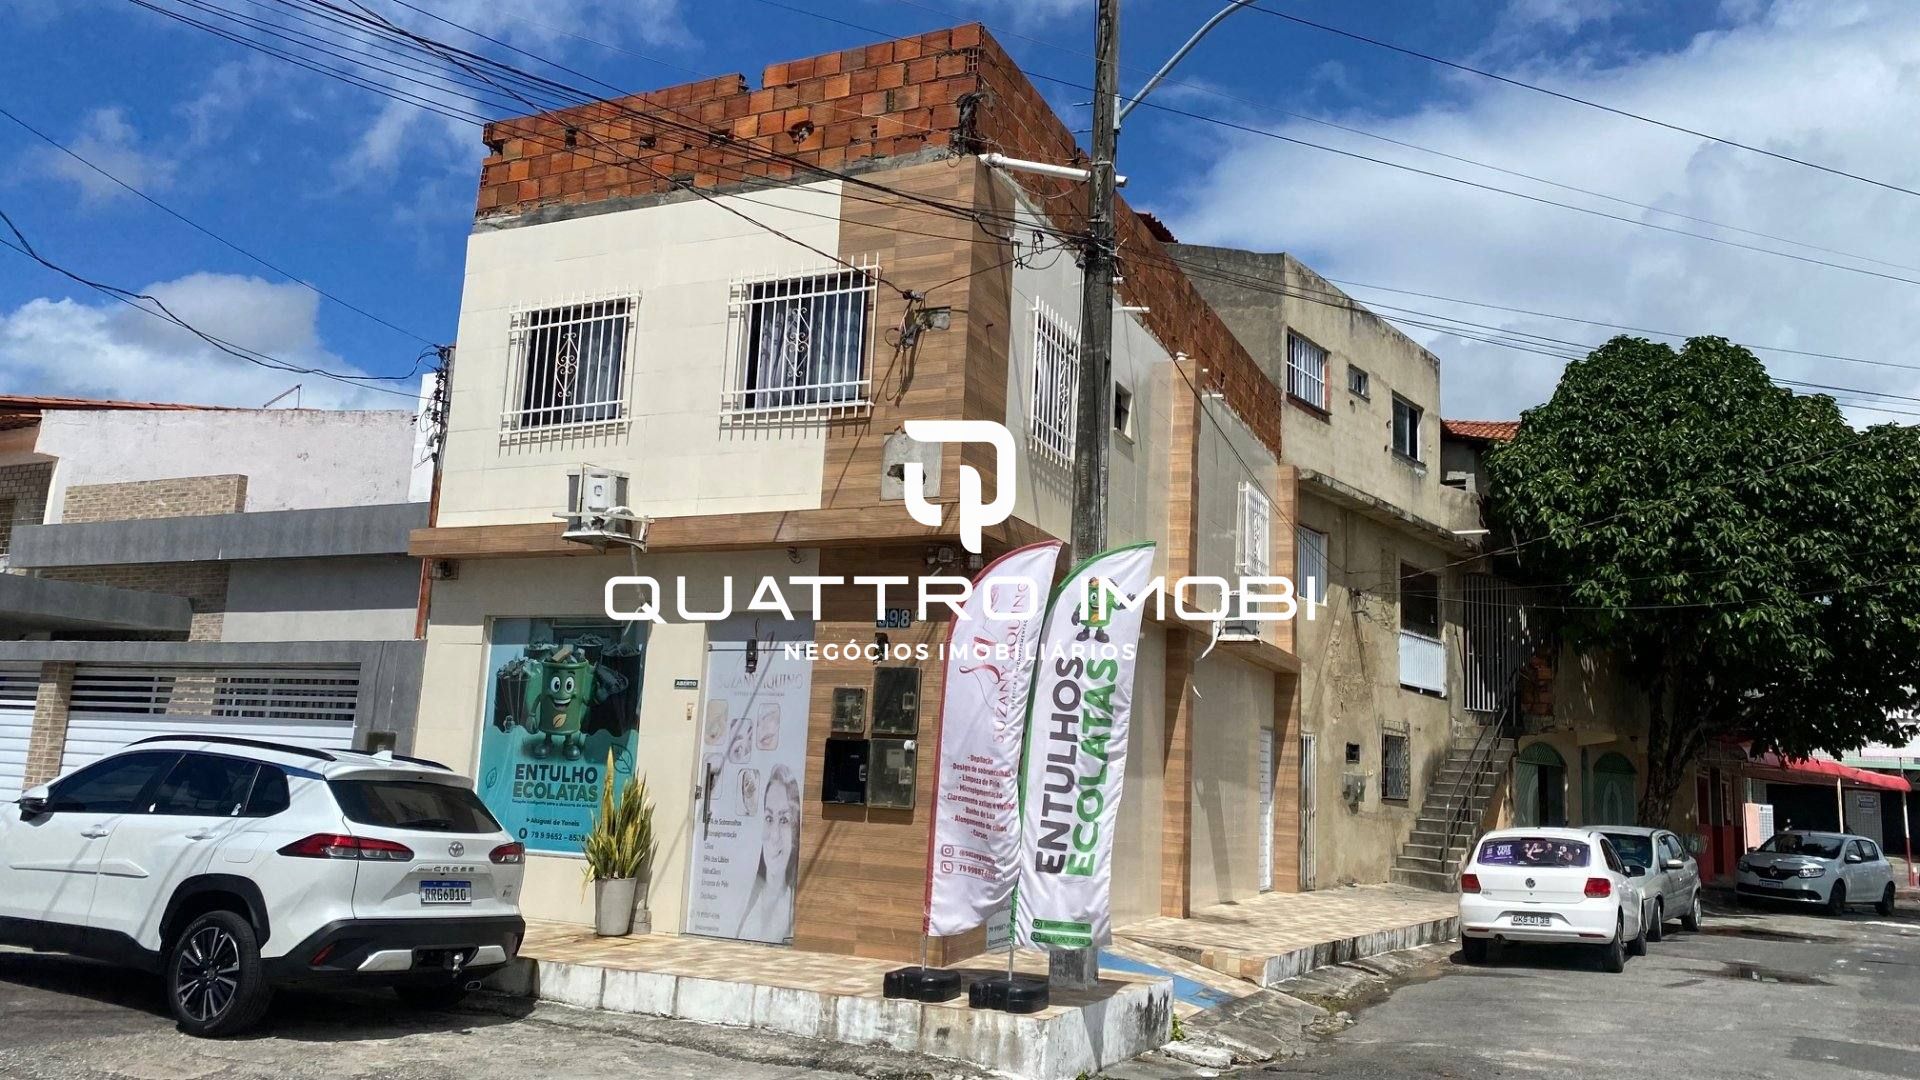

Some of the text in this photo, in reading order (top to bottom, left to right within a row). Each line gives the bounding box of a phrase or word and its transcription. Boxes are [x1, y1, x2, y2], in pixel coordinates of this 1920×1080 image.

[993, 665, 1010, 744] SUZANY
[952, 762, 971, 772] Design
[1036, 656, 1084, 874] ENTULHOS
[1066, 657, 1119, 876] ECOLATAS
[515, 763, 598, 784] ENTULHO
[962, 774, 982, 784] Limpeza
[513, 781, 598, 802] ECOLATAS
[947, 792, 978, 805] Clareamento
[531, 818, 552, 826] Aluguel
[954, 814, 985, 828] Alongamento
[959, 864, 967, 872] 79
[425, 888, 467, 902] RRG6D10
